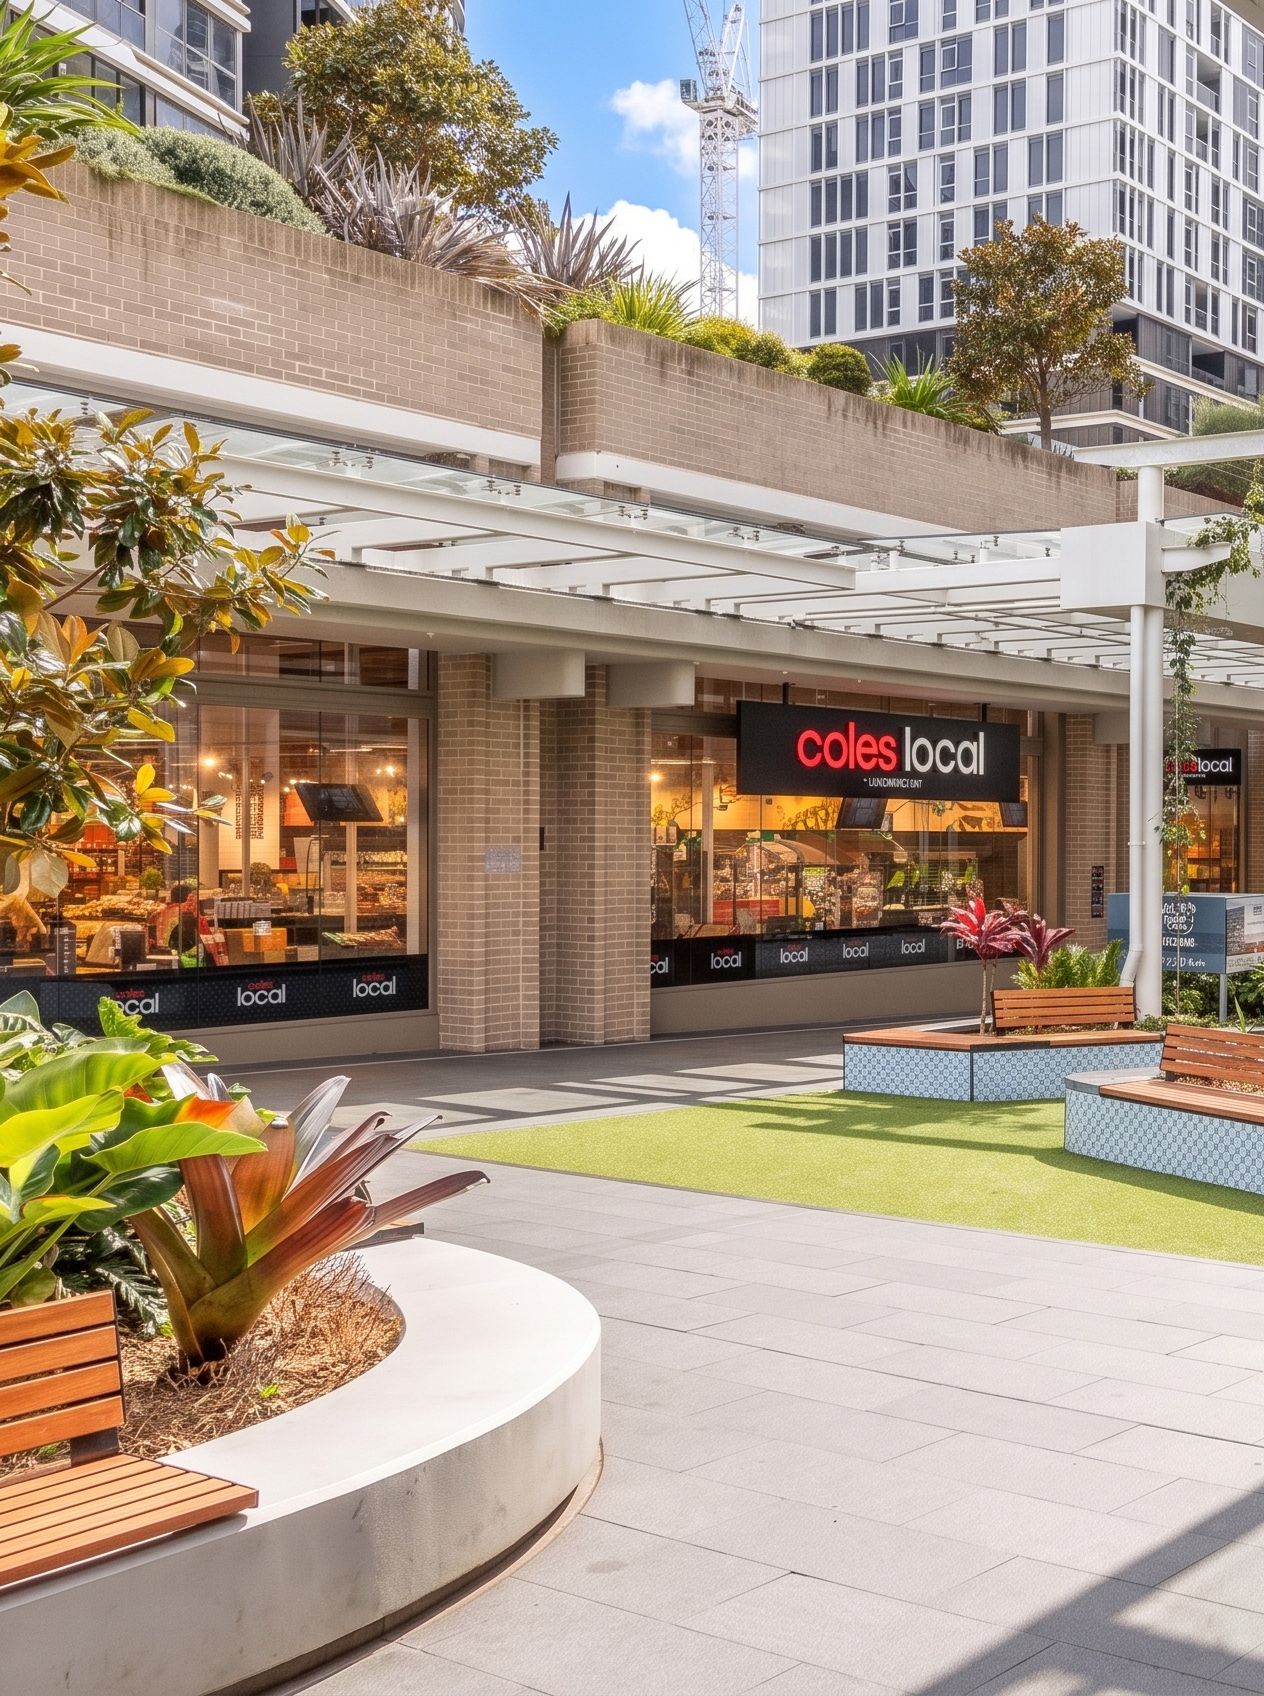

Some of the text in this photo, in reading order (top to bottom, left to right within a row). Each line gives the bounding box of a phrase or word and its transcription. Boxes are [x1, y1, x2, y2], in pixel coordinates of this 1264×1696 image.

[797, 722, 985, 775] coles local
[1198, 757, 1233, 772] local
[842, 942, 869, 959] local
[901, 938, 926, 954] local
[711, 951, 742, 969] local
[780, 947, 808, 963] local
[650, 957, 669, 974] cal
[237, 983, 286, 1007] local
[353, 975, 396, 998] local
